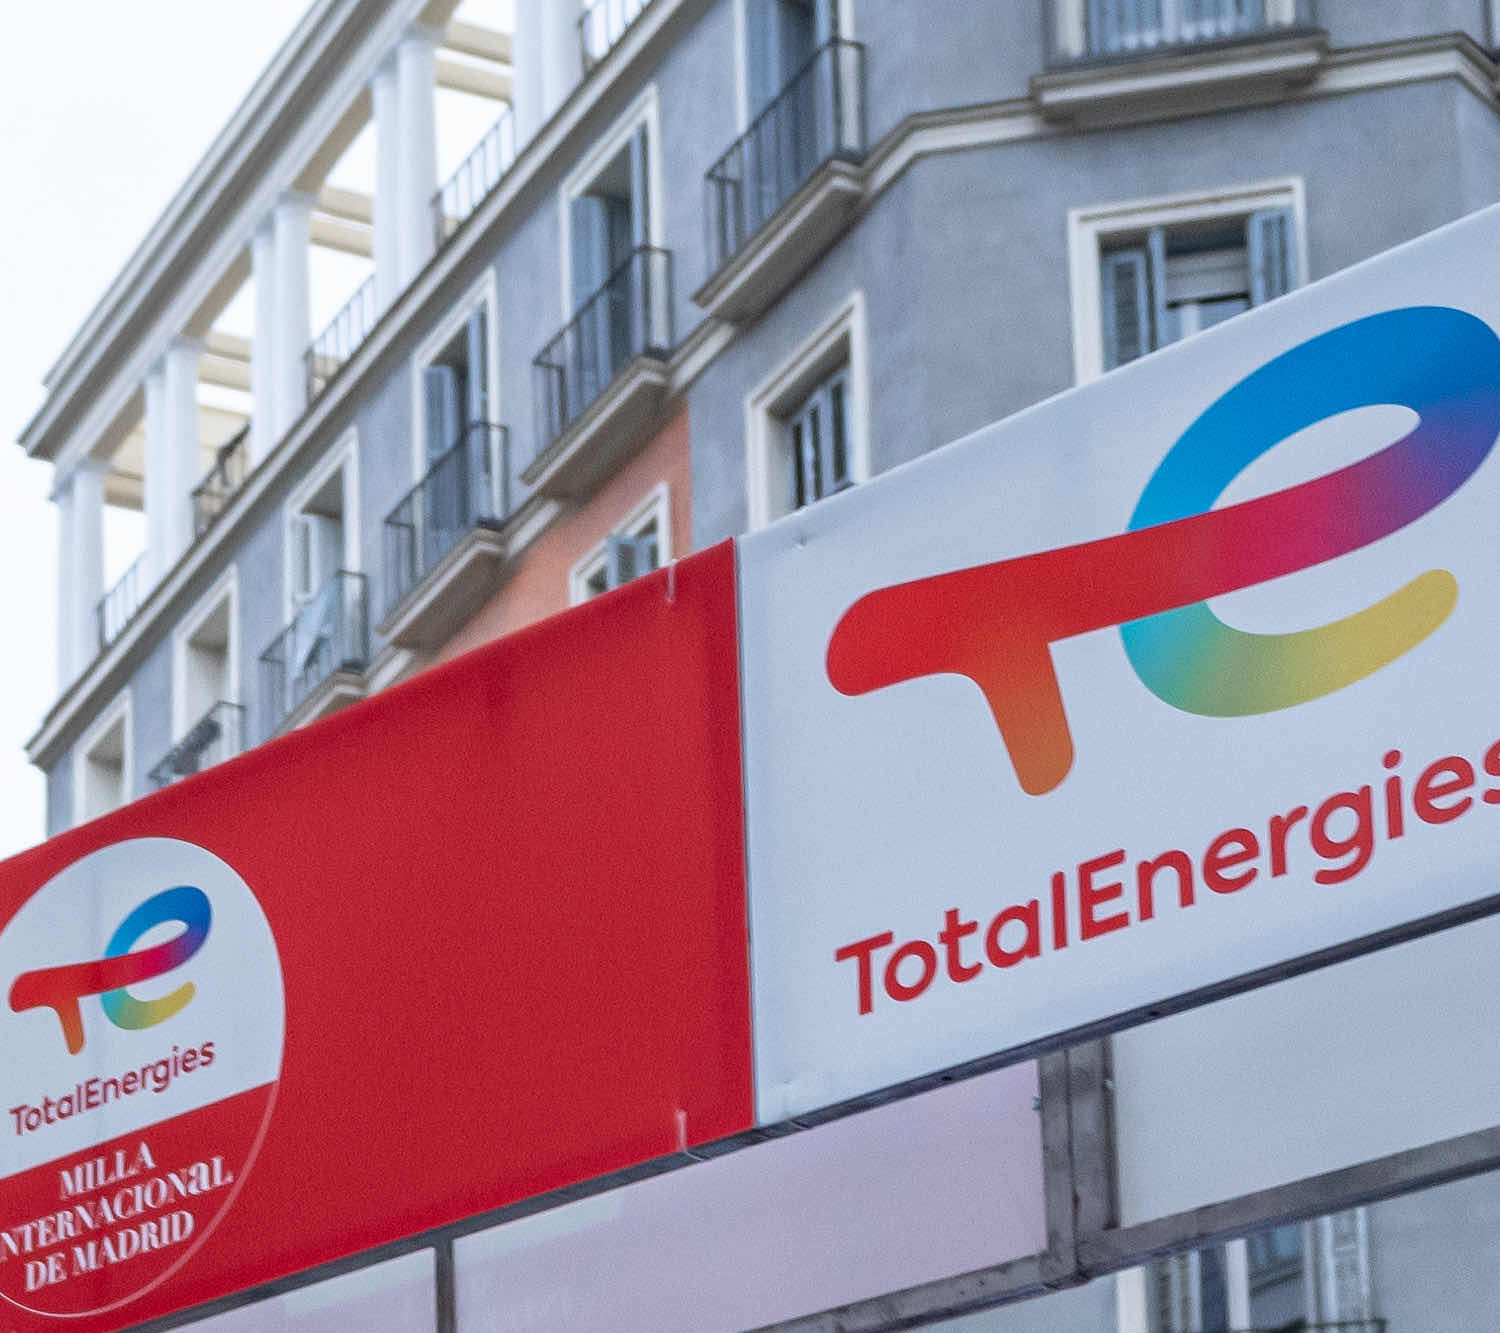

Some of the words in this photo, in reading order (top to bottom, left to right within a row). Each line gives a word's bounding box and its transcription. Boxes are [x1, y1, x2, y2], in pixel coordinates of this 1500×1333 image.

[8, 1039, 215, 1136] TotalEnergies
[58, 1141, 156, 1200] MILLA
[24, 1251, 67, 1293] DE
[71, 1210, 196, 1277] MADRID
